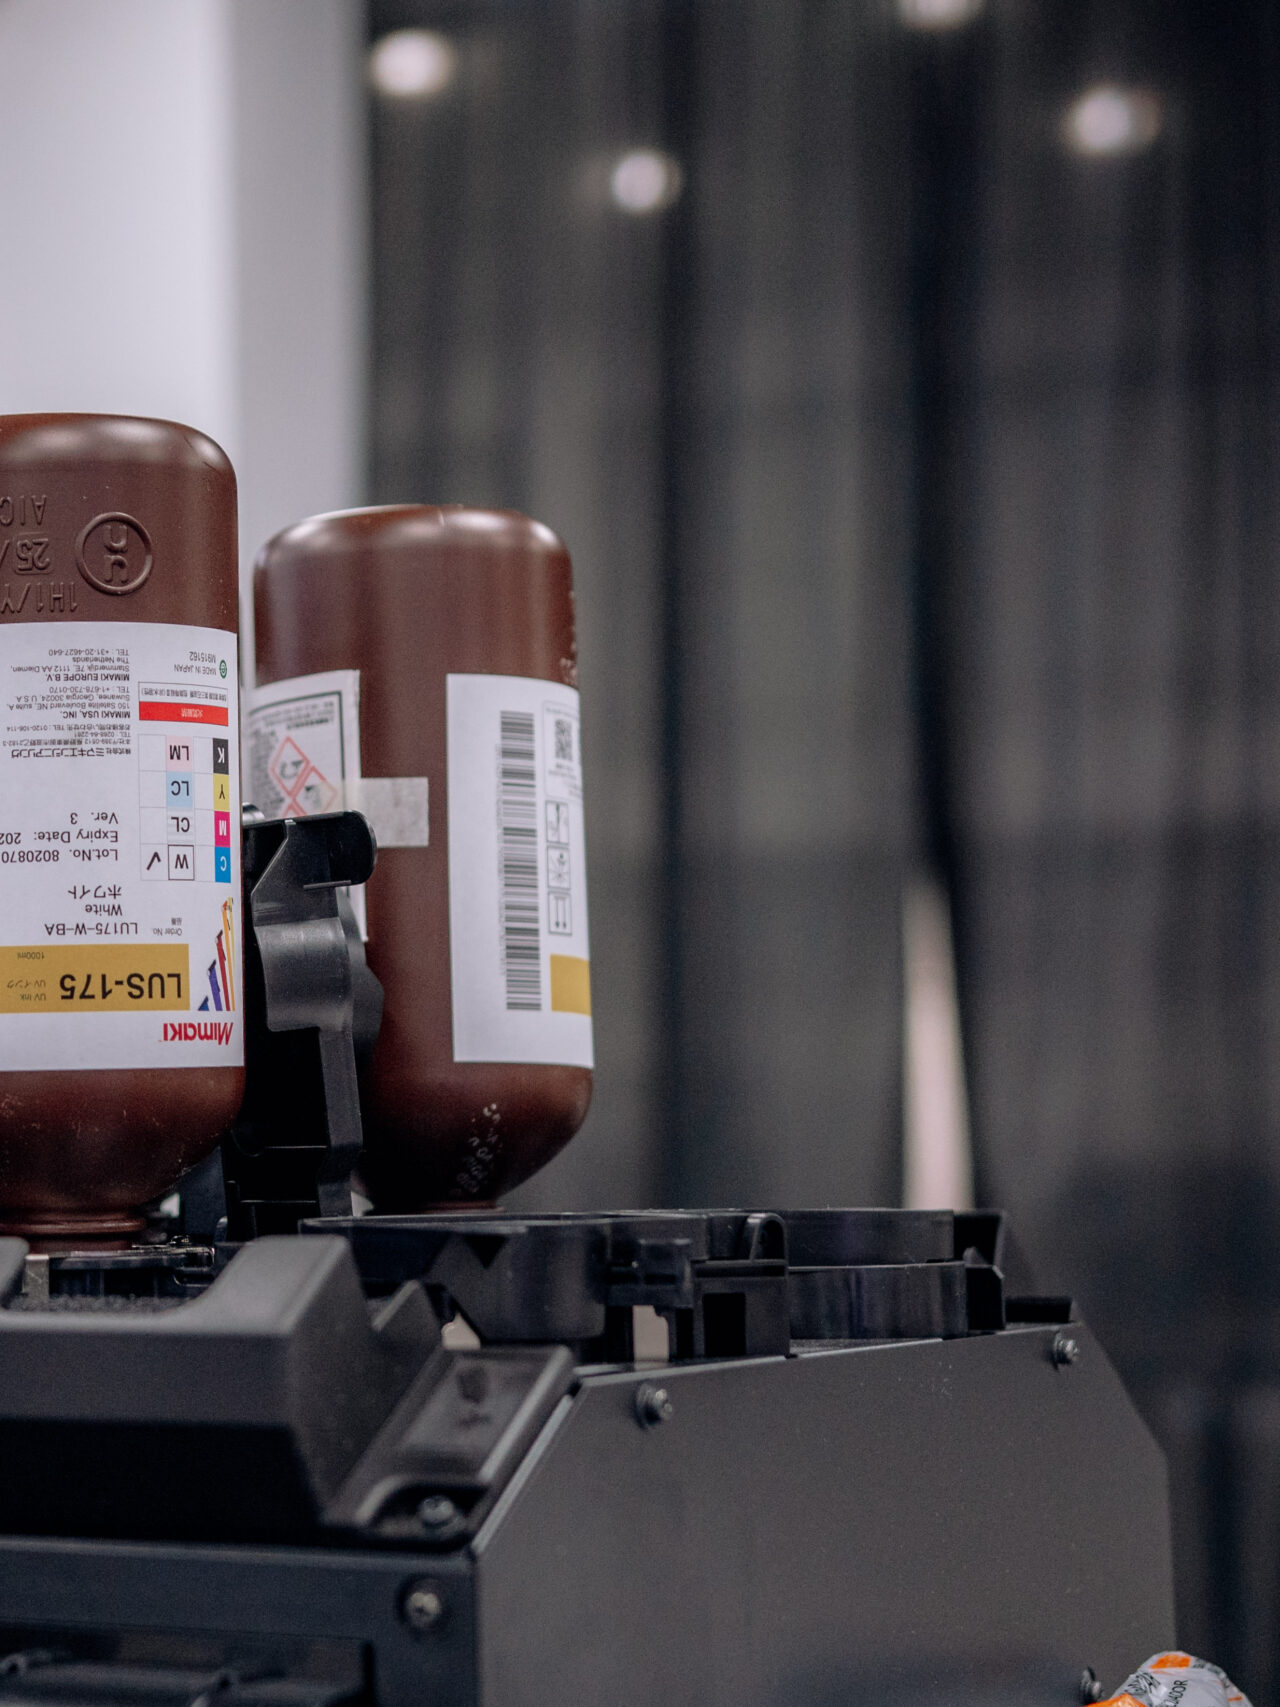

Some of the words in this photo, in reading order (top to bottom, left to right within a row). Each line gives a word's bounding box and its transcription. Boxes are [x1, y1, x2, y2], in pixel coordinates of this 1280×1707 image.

[189, 652, 216, 663] M915162
[174, 664, 194, 673] JAPAN
[195, 666, 200, 674] IN
[202, 667, 216, 675] MADE
[66, 693, 94, 702] Georgia
[80, 710, 99, 718] USA,
[169, 745, 189, 760] LM
[217, 747, 225, 763] K
[171, 780, 189, 796] LC
[219, 784, 225, 800] Y
[70, 812, 78, 824] 3
[91, 812, 118, 824] Ver.
[171, 816, 190, 832] CL
[219, 820, 226, 835] M
[34, 831, 70, 844] Date:
[76, 829, 118, 842] Expiry
[175, 854, 188, 869] W
[220, 857, 226, 871] C
[68, 885, 122, 899] ホワイト
[85, 904, 122, 916] White
[44, 922, 138, 936] LU175-W-BA
[152, 928, 162, 936] No.
[164, 928, 182, 936] Order
[60, 972, 181, 1000] LUS-175
[34, 993, 46, 1001] UV
